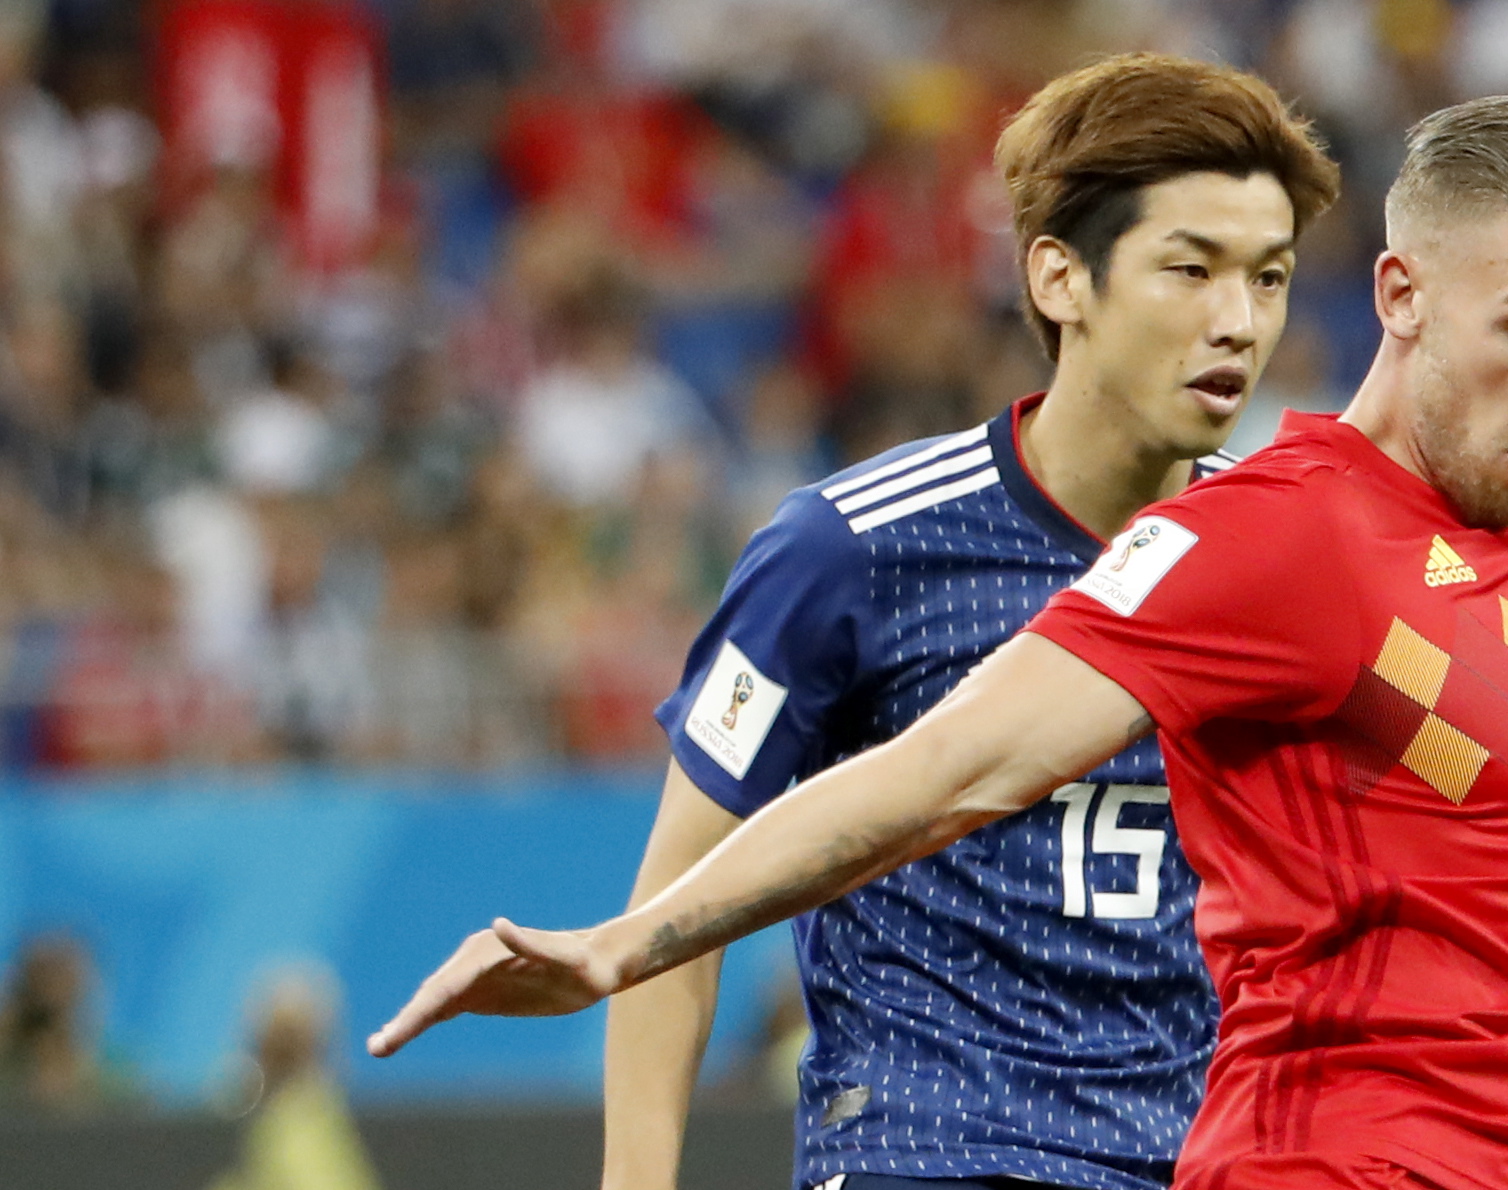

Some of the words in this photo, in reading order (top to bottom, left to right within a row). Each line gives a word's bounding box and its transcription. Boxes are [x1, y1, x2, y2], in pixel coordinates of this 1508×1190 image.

[1424, 565, 1478, 588] adidas
[1104, 586, 1131, 607] 2018
[1050, 782, 1170, 919] 15
